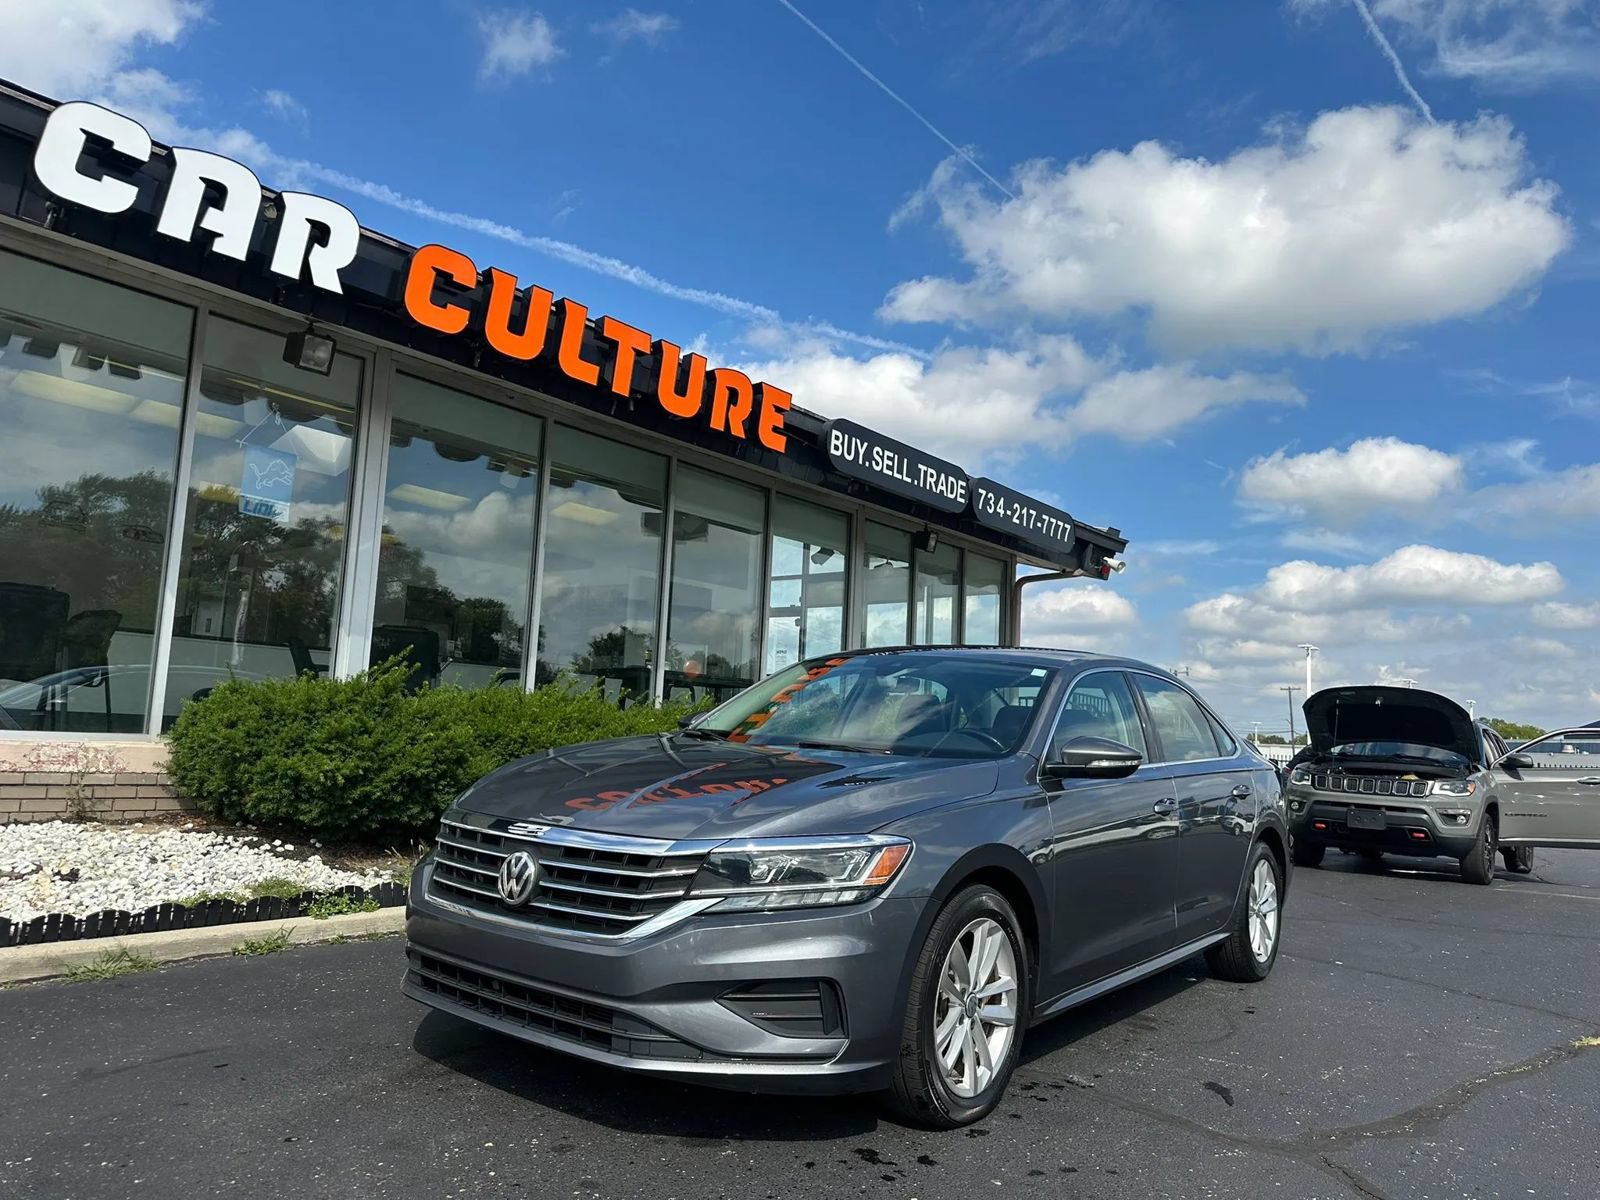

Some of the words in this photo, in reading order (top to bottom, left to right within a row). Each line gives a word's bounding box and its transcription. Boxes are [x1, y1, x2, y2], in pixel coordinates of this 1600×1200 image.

[34, 102, 360, 294] CAR
[405, 244, 792, 453] CULTURE
[978, 487, 1071, 543] 734-217-7777
